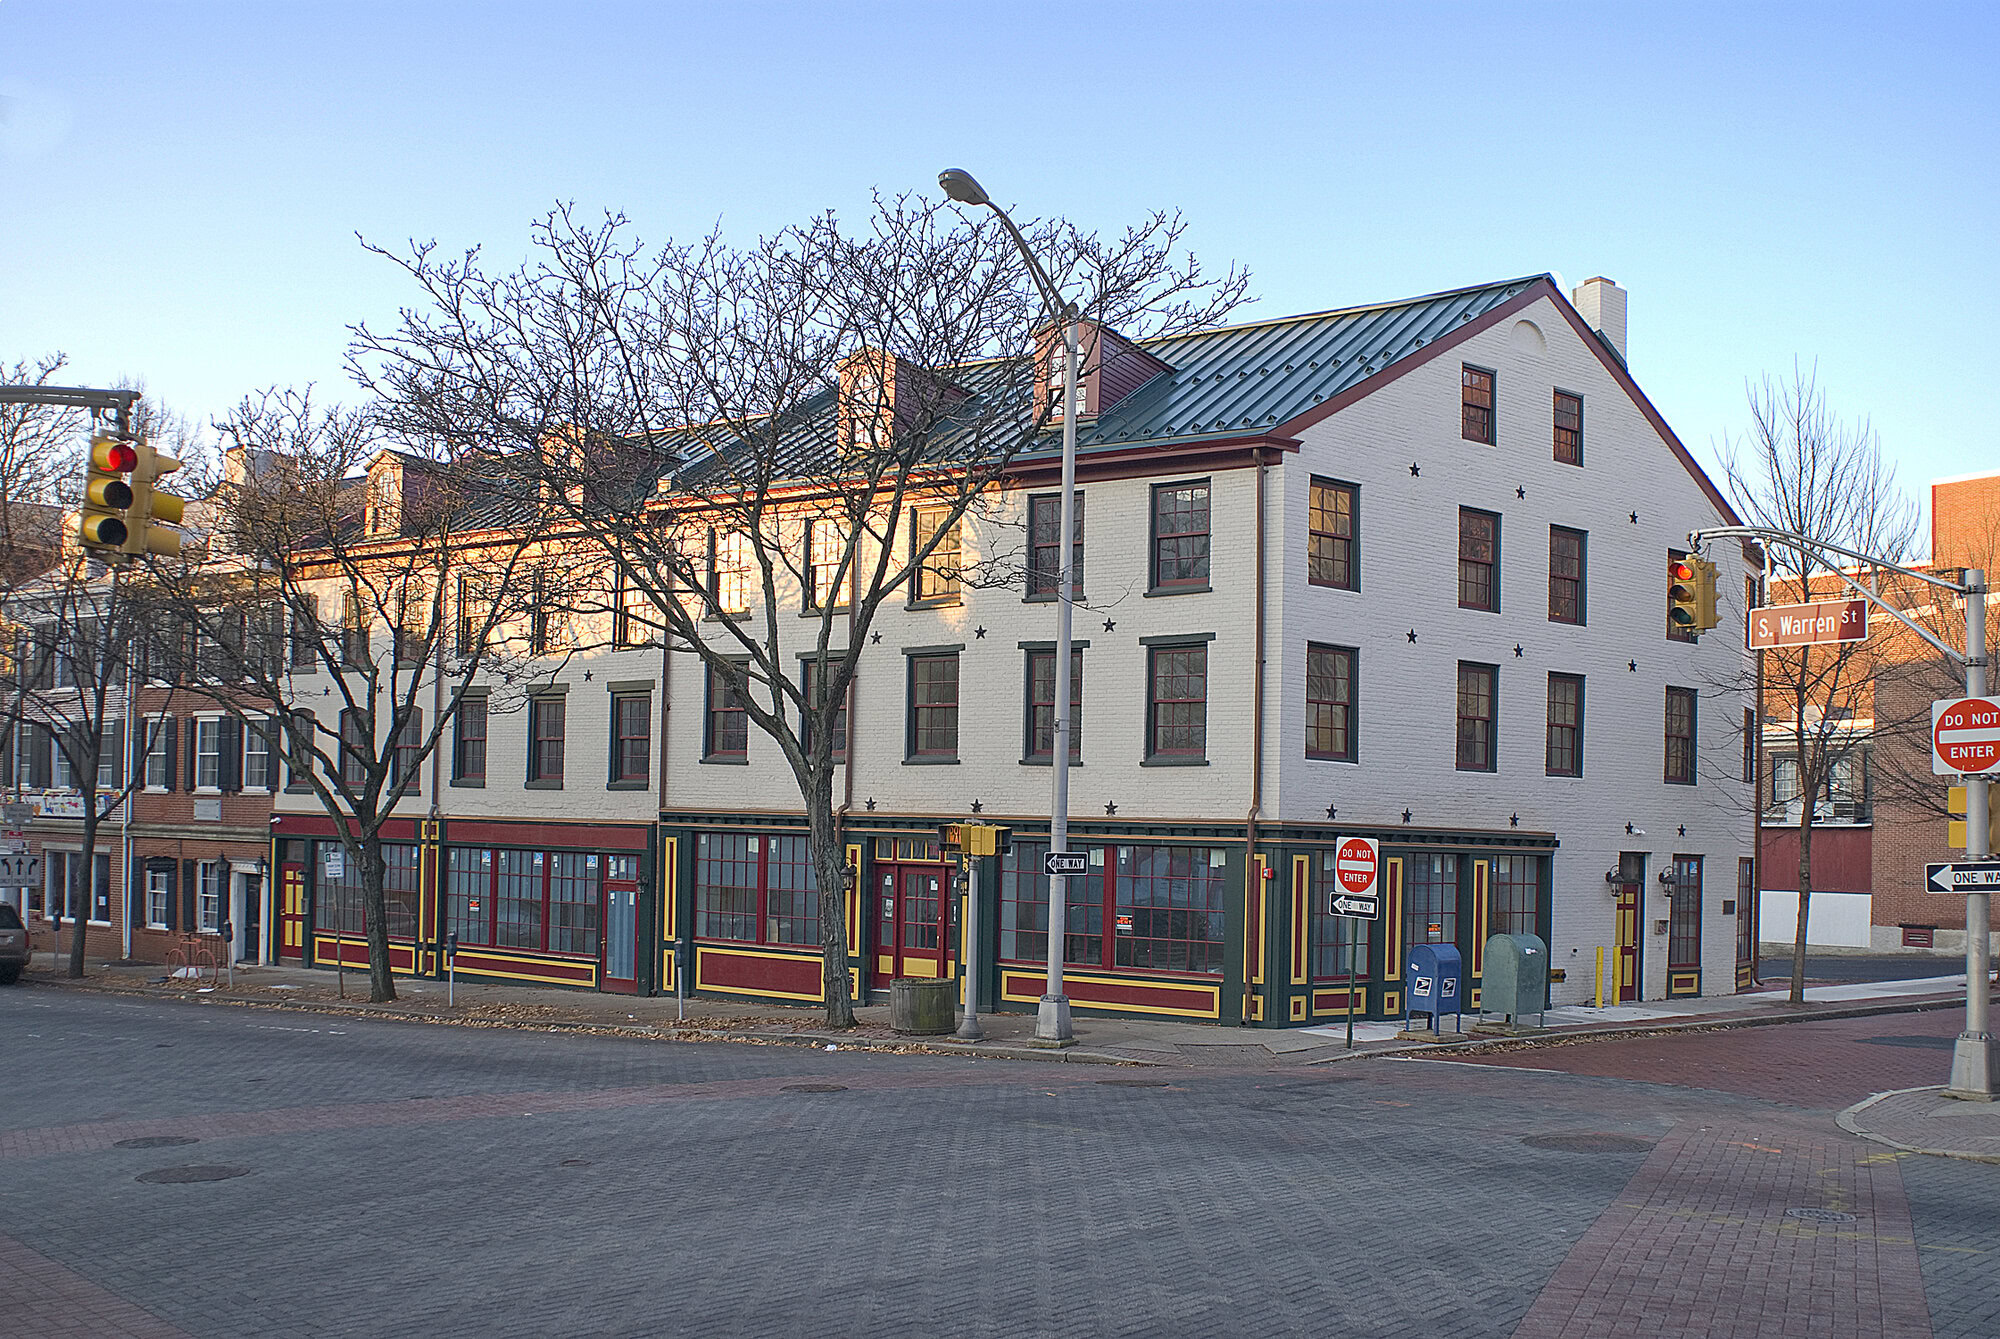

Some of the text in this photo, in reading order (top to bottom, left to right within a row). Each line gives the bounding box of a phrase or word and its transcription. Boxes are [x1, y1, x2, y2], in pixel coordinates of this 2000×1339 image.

[1758, 610, 1857, 638] S. Warren St
[1945, 712, 1999, 727] DO NOT
[1951, 745, 1994, 759] ENTER
[1342, 848, 1371, 859] DO NOT
[1050, 859, 1083, 869] ONE WAY
[1344, 872, 1368, 884] ENTER
[1954, 872, 2000, 884] ONE WA
[1338, 900, 1372, 911] ONE WAY
